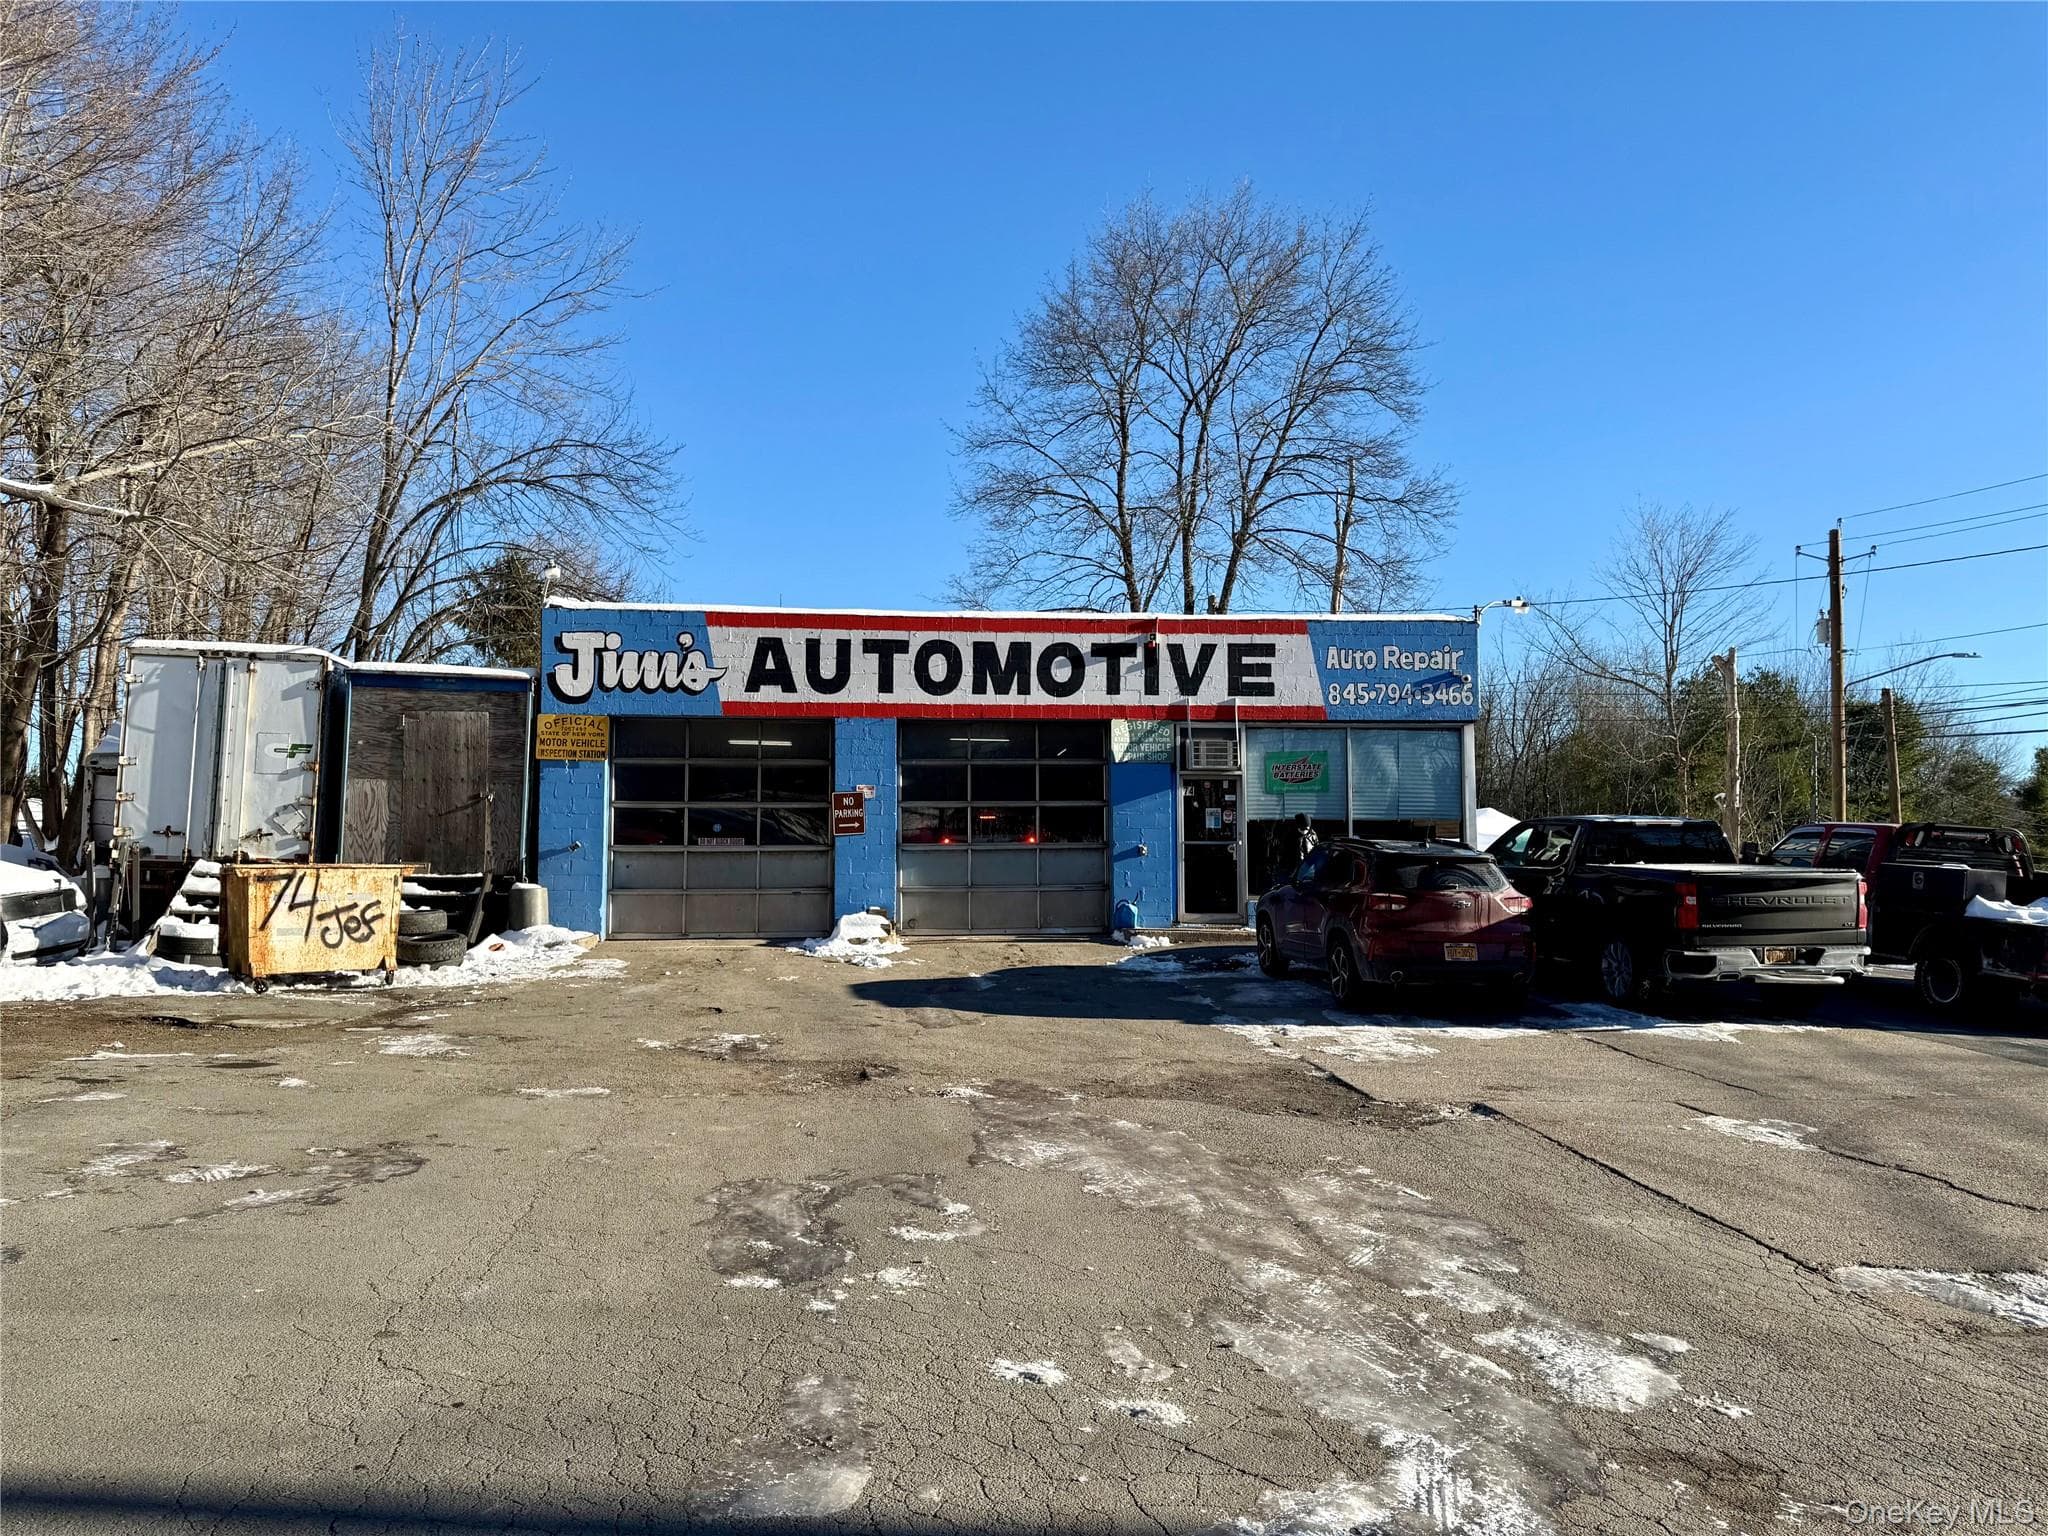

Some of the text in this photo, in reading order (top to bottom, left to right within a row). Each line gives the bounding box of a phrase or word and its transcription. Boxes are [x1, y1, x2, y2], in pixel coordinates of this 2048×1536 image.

[1327, 645, 1464, 671] Auto Repair
[549, 631, 728, 703] Jim's
[744, 637, 1276, 698] AUTOMOTIVE
[544, 717, 603, 731] OFFICIAL
[1114, 720, 1170, 736] REGISTERED
[539, 737, 606, 748] MOTOR VEHICLE
[1140, 743, 1171, 752] VEHICLE
[538, 749, 607, 759] INSPECTION STATION
[1147, 752, 1168, 760] SHOP
[1272, 763, 1322, 771] INTERSTATE
[1273, 770, 1320, 779] BATTERIES
[842, 796, 855, 806] NO
[834, 808, 864, 818] PARKING
[256, 868, 321, 943] 74
[1711, 896, 1851, 906] CHEVROLET
